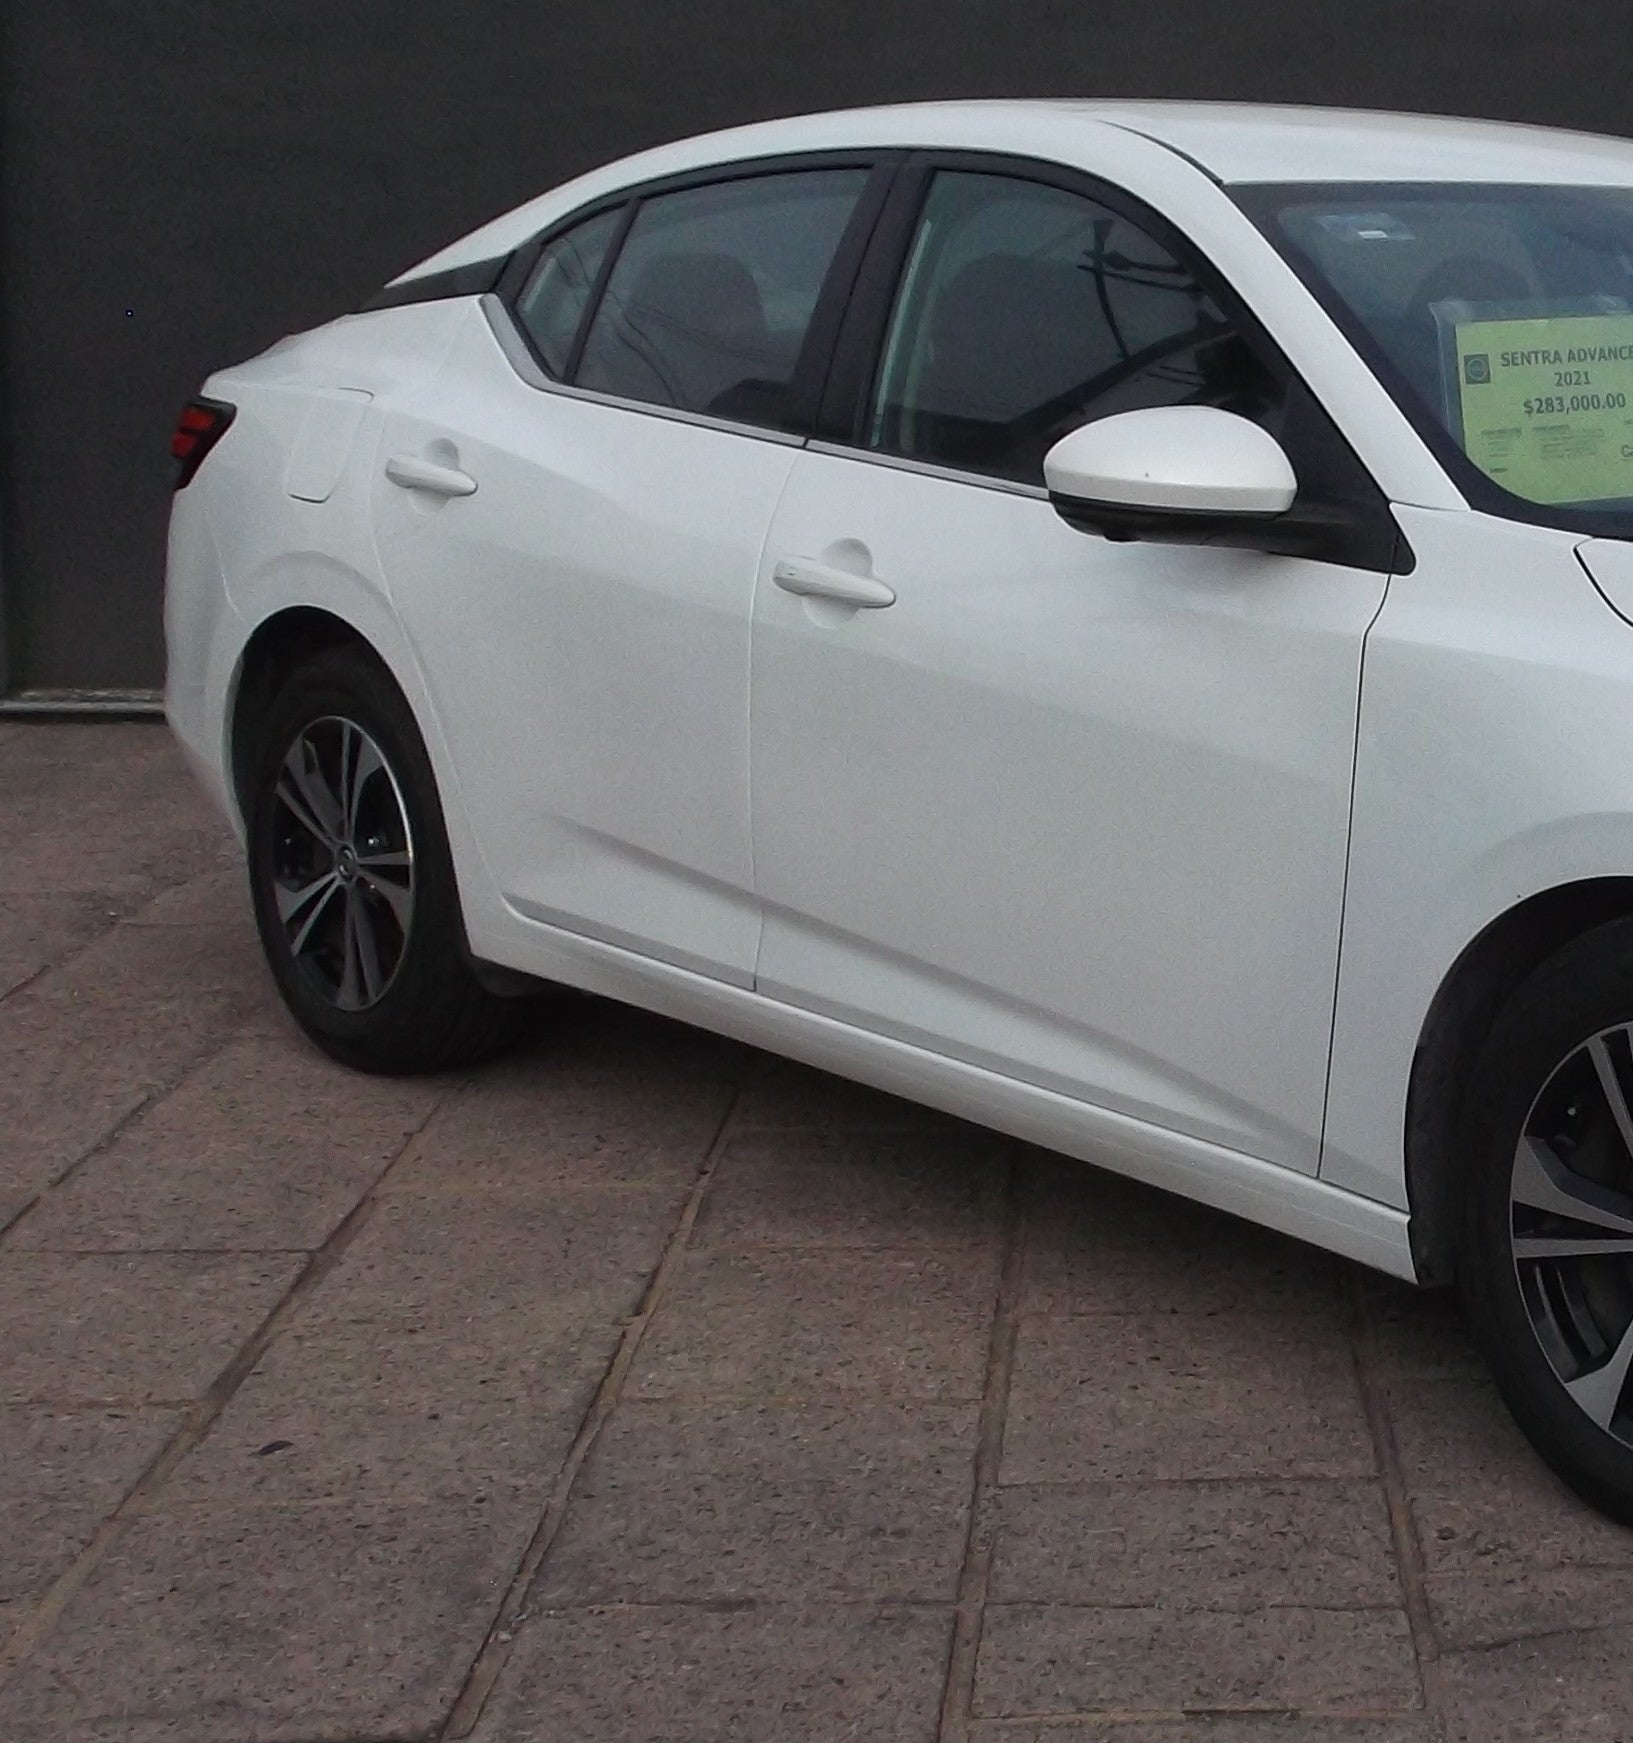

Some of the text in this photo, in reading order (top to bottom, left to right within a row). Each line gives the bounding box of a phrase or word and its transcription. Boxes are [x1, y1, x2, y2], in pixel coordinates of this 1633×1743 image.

[1500, 350, 1563, 368] SENTRA
[1554, 370, 1592, 388] 2021
[1523, 392, 1627, 417] $283,000.00
